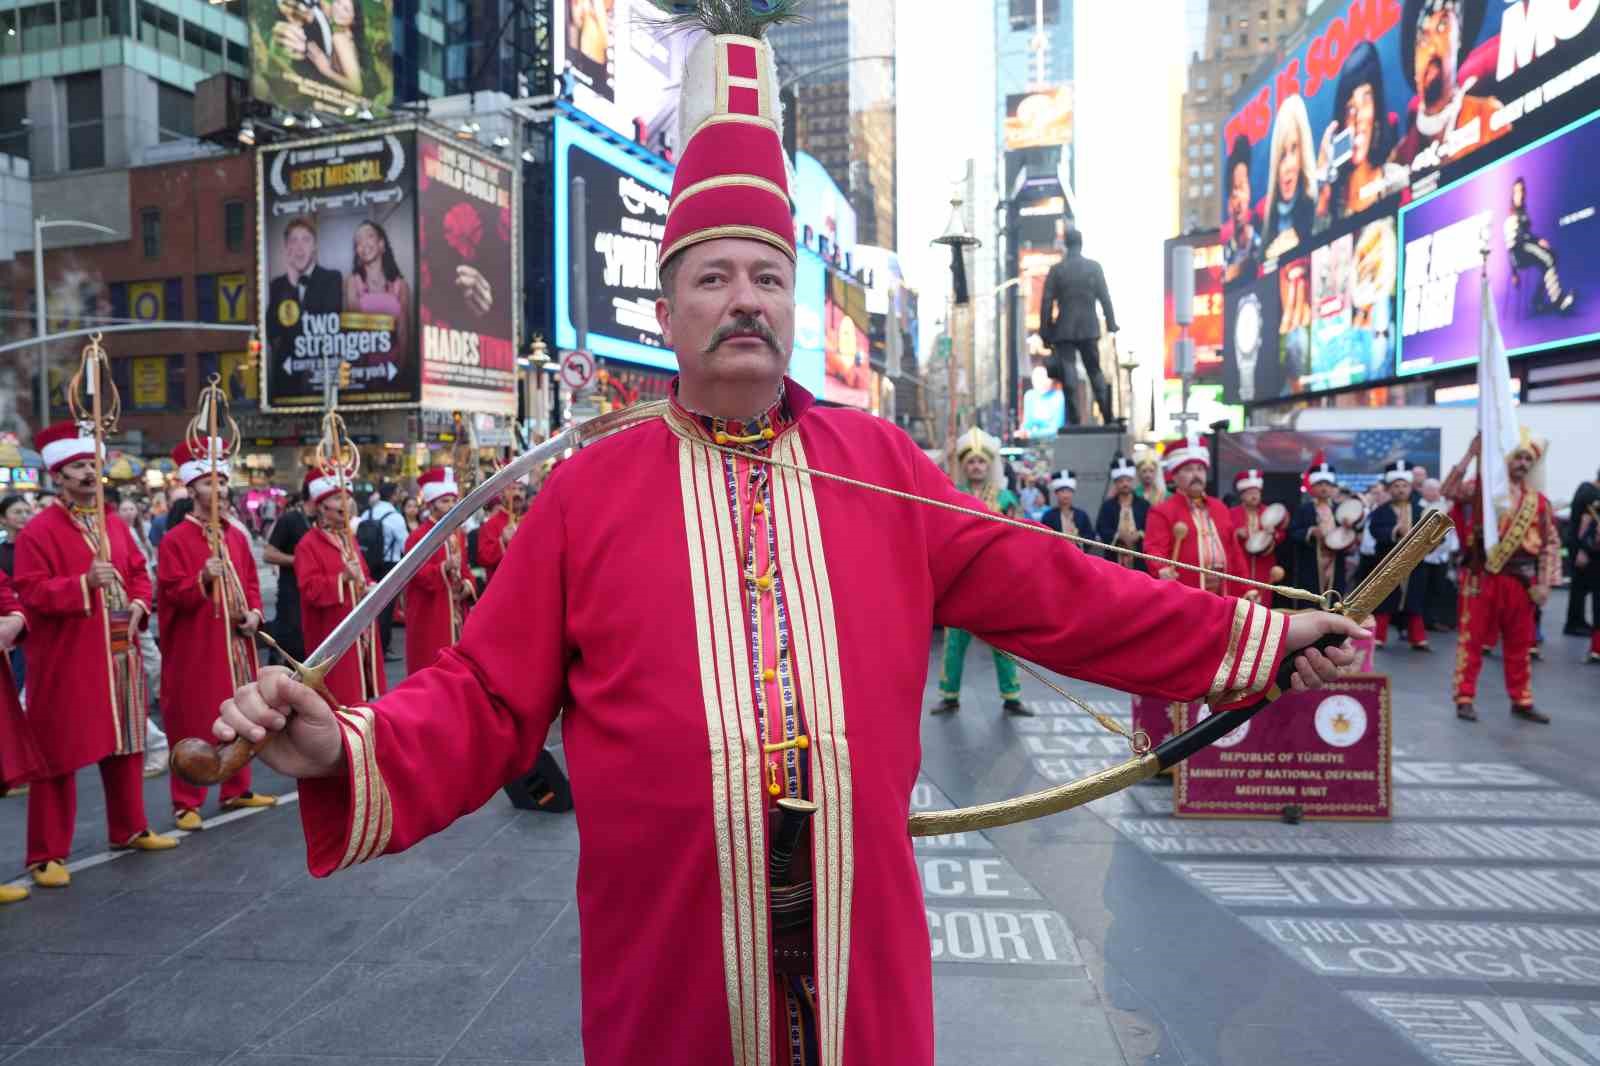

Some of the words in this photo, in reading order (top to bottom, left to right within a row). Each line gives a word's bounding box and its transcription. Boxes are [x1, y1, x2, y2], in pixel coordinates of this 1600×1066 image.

[301, 311, 340, 336] two
[294, 331, 391, 361] strangers
[1220, 751, 1275, 763] REPUBLIC
[1278, 752, 1294, 763] OF
[1189, 768, 1246, 780] MINISTRY
[1247, 769, 1263, 780] OF
[1264, 769, 1323, 781] NATIONAL
[1324, 770, 1376, 781] DEFENSE
[1300, 785, 1328, 797] UNIT
[1266, 918, 1371, 944] ETHEL
